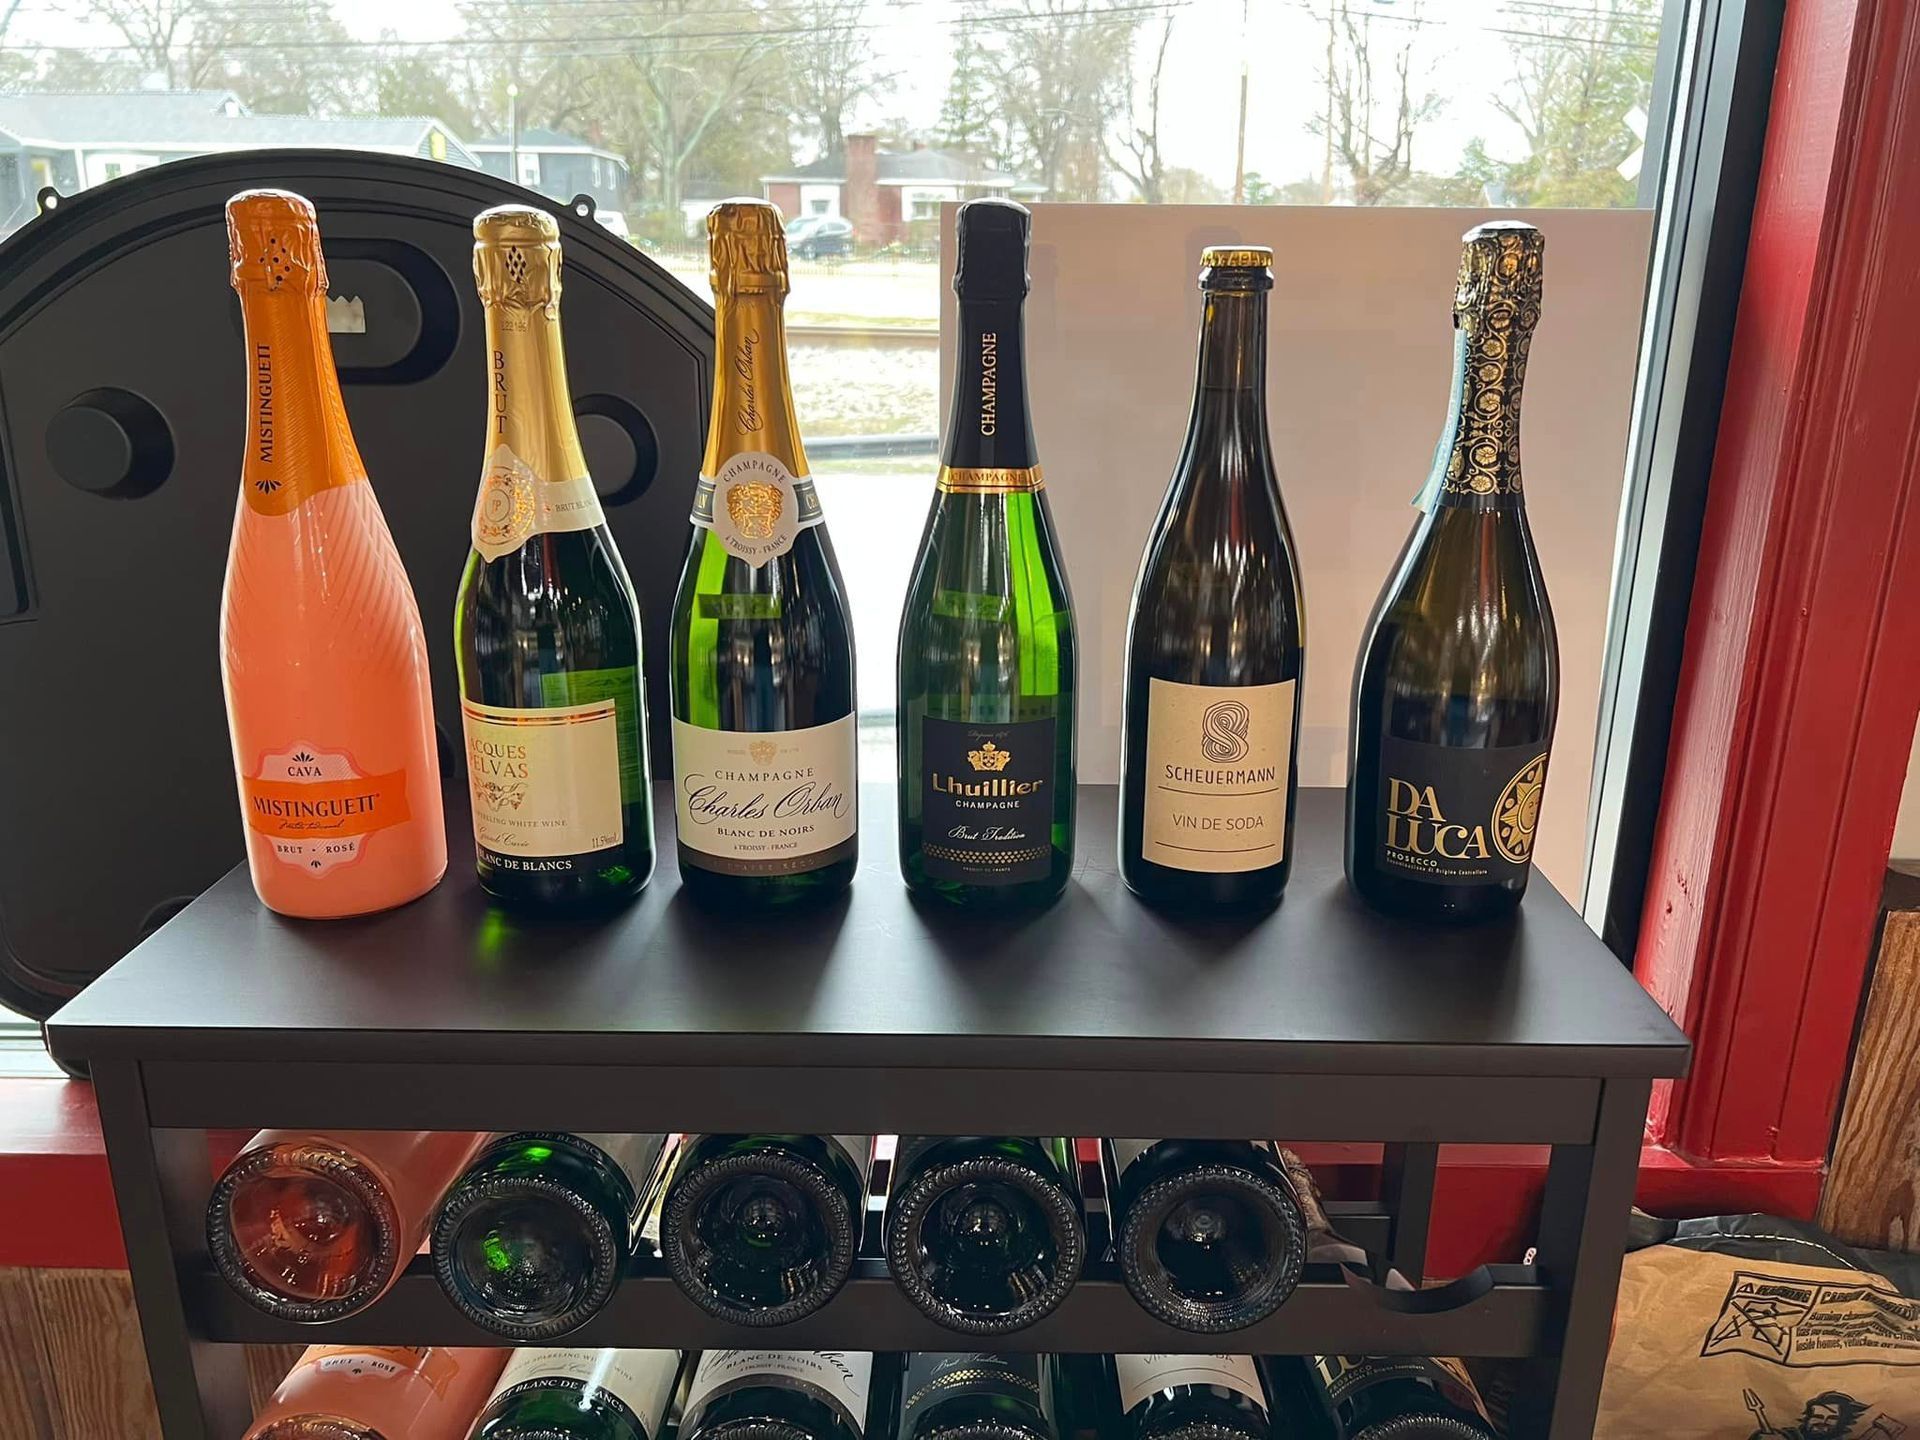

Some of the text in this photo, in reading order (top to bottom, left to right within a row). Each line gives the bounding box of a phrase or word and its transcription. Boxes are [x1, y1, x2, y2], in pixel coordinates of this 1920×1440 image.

[735, 328, 763, 435] Charles Orban
[980, 332, 997, 436] CHAMPAGNE
[493, 351, 508, 434] BRUT
[257, 342, 273, 463] MISTINGUETT
[723, 460, 787, 484] CHAMPAGNE
[287, 766, 322, 777] CAVA
[714, 768, 815, 782] CHAMPAGNE
[1165, 765, 1276, 785] SCHEUERMANN
[932, 773, 1043, 797] Lhuillier
[254, 794, 375, 817] MISTINGUETT
[684, 773, 850, 824] Charles Orban
[955, 800, 1020, 809] CHAMPAGNE
[1387, 777, 1447, 822] DA
[509, 819, 538, 829] WHITE
[542, 819, 568, 827] WINE
[1172, 814, 1264, 831] VIN DE SODA
[717, 827, 756, 838] BLANC
[780, 825, 815, 836] NOIRS
[948, 825, 1026, 840] Brut Tradition
[1384, 813, 1492, 859] LUCA
[277, 842, 355, 854] BRUT ROSÉ
[504, 859, 520, 870] DE
[523, 860, 573, 872] BLANCS
[1386, 850, 1438, 867] PROSECCO
[768, 1353, 785, 1361] DE
[515, 1379, 558, 1393] BLANC
[560, 1380, 579, 1391] DE
